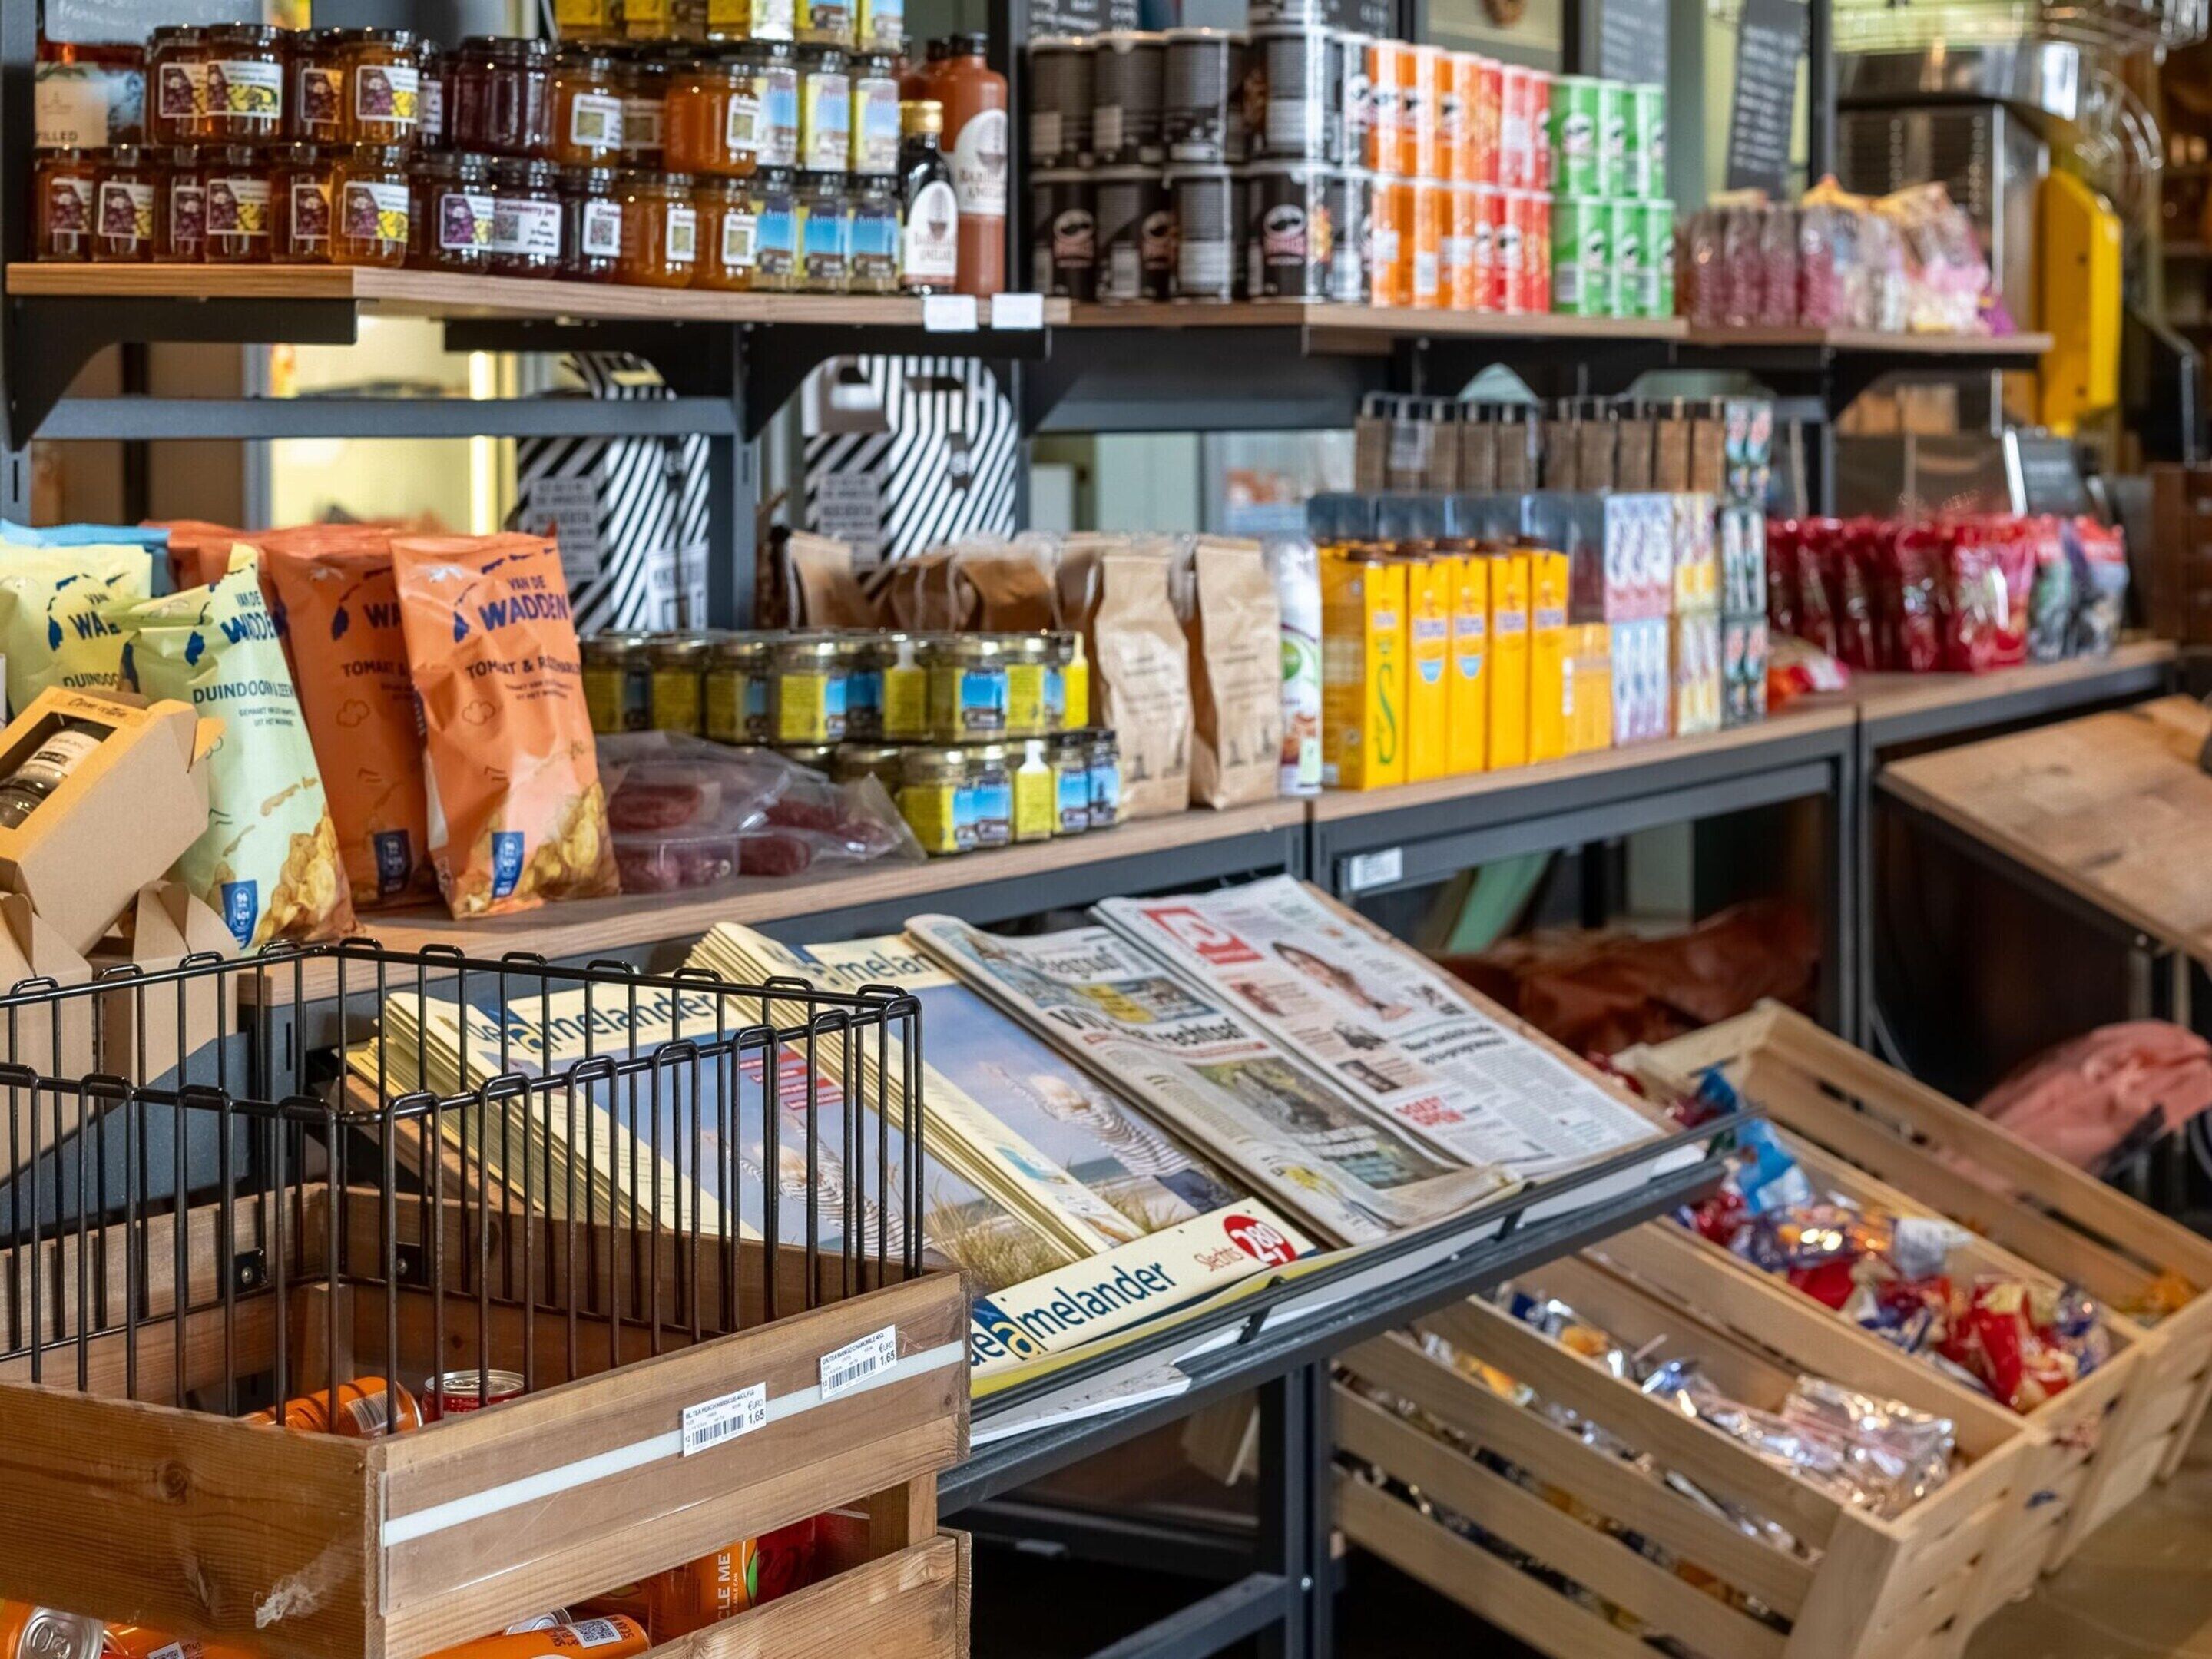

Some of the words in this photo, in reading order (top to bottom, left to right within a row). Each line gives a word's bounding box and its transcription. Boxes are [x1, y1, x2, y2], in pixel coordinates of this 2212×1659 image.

[531, 575, 546, 589] DE
[478, 594, 569, 631] WADDEN
[880, 1350, 895, 1366] 1,65
[748, 1409, 764, 1425] 1,65
[717, 1552, 731, 1582] ME
